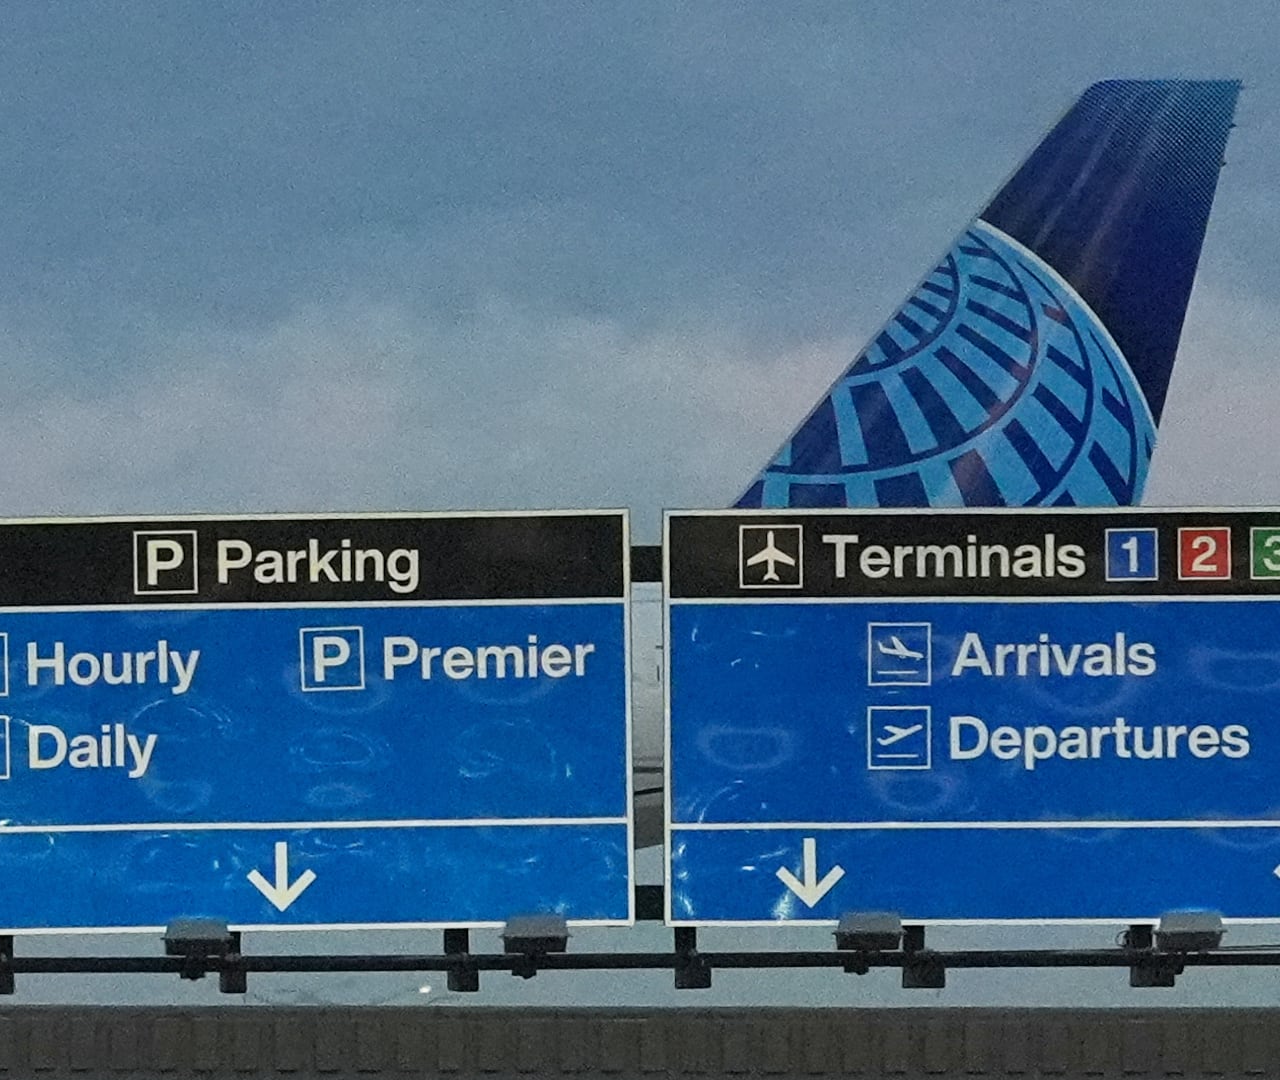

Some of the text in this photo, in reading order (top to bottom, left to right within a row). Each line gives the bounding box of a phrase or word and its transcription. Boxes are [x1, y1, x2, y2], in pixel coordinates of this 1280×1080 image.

[147, 538, 420, 593] P Parking
[822, 533, 1087, 579] Terminals
[1121, 536, 1138, 573] 1
[1191, 535, 1217, 572] 2
[27, 640, 201, 696] Hourly
[313, 635, 595, 682] P Premier
[951, 632, 1157, 677] Arrivals
[27, 723, 158, 779] Daily
[950, 716, 1250, 770] Departures
